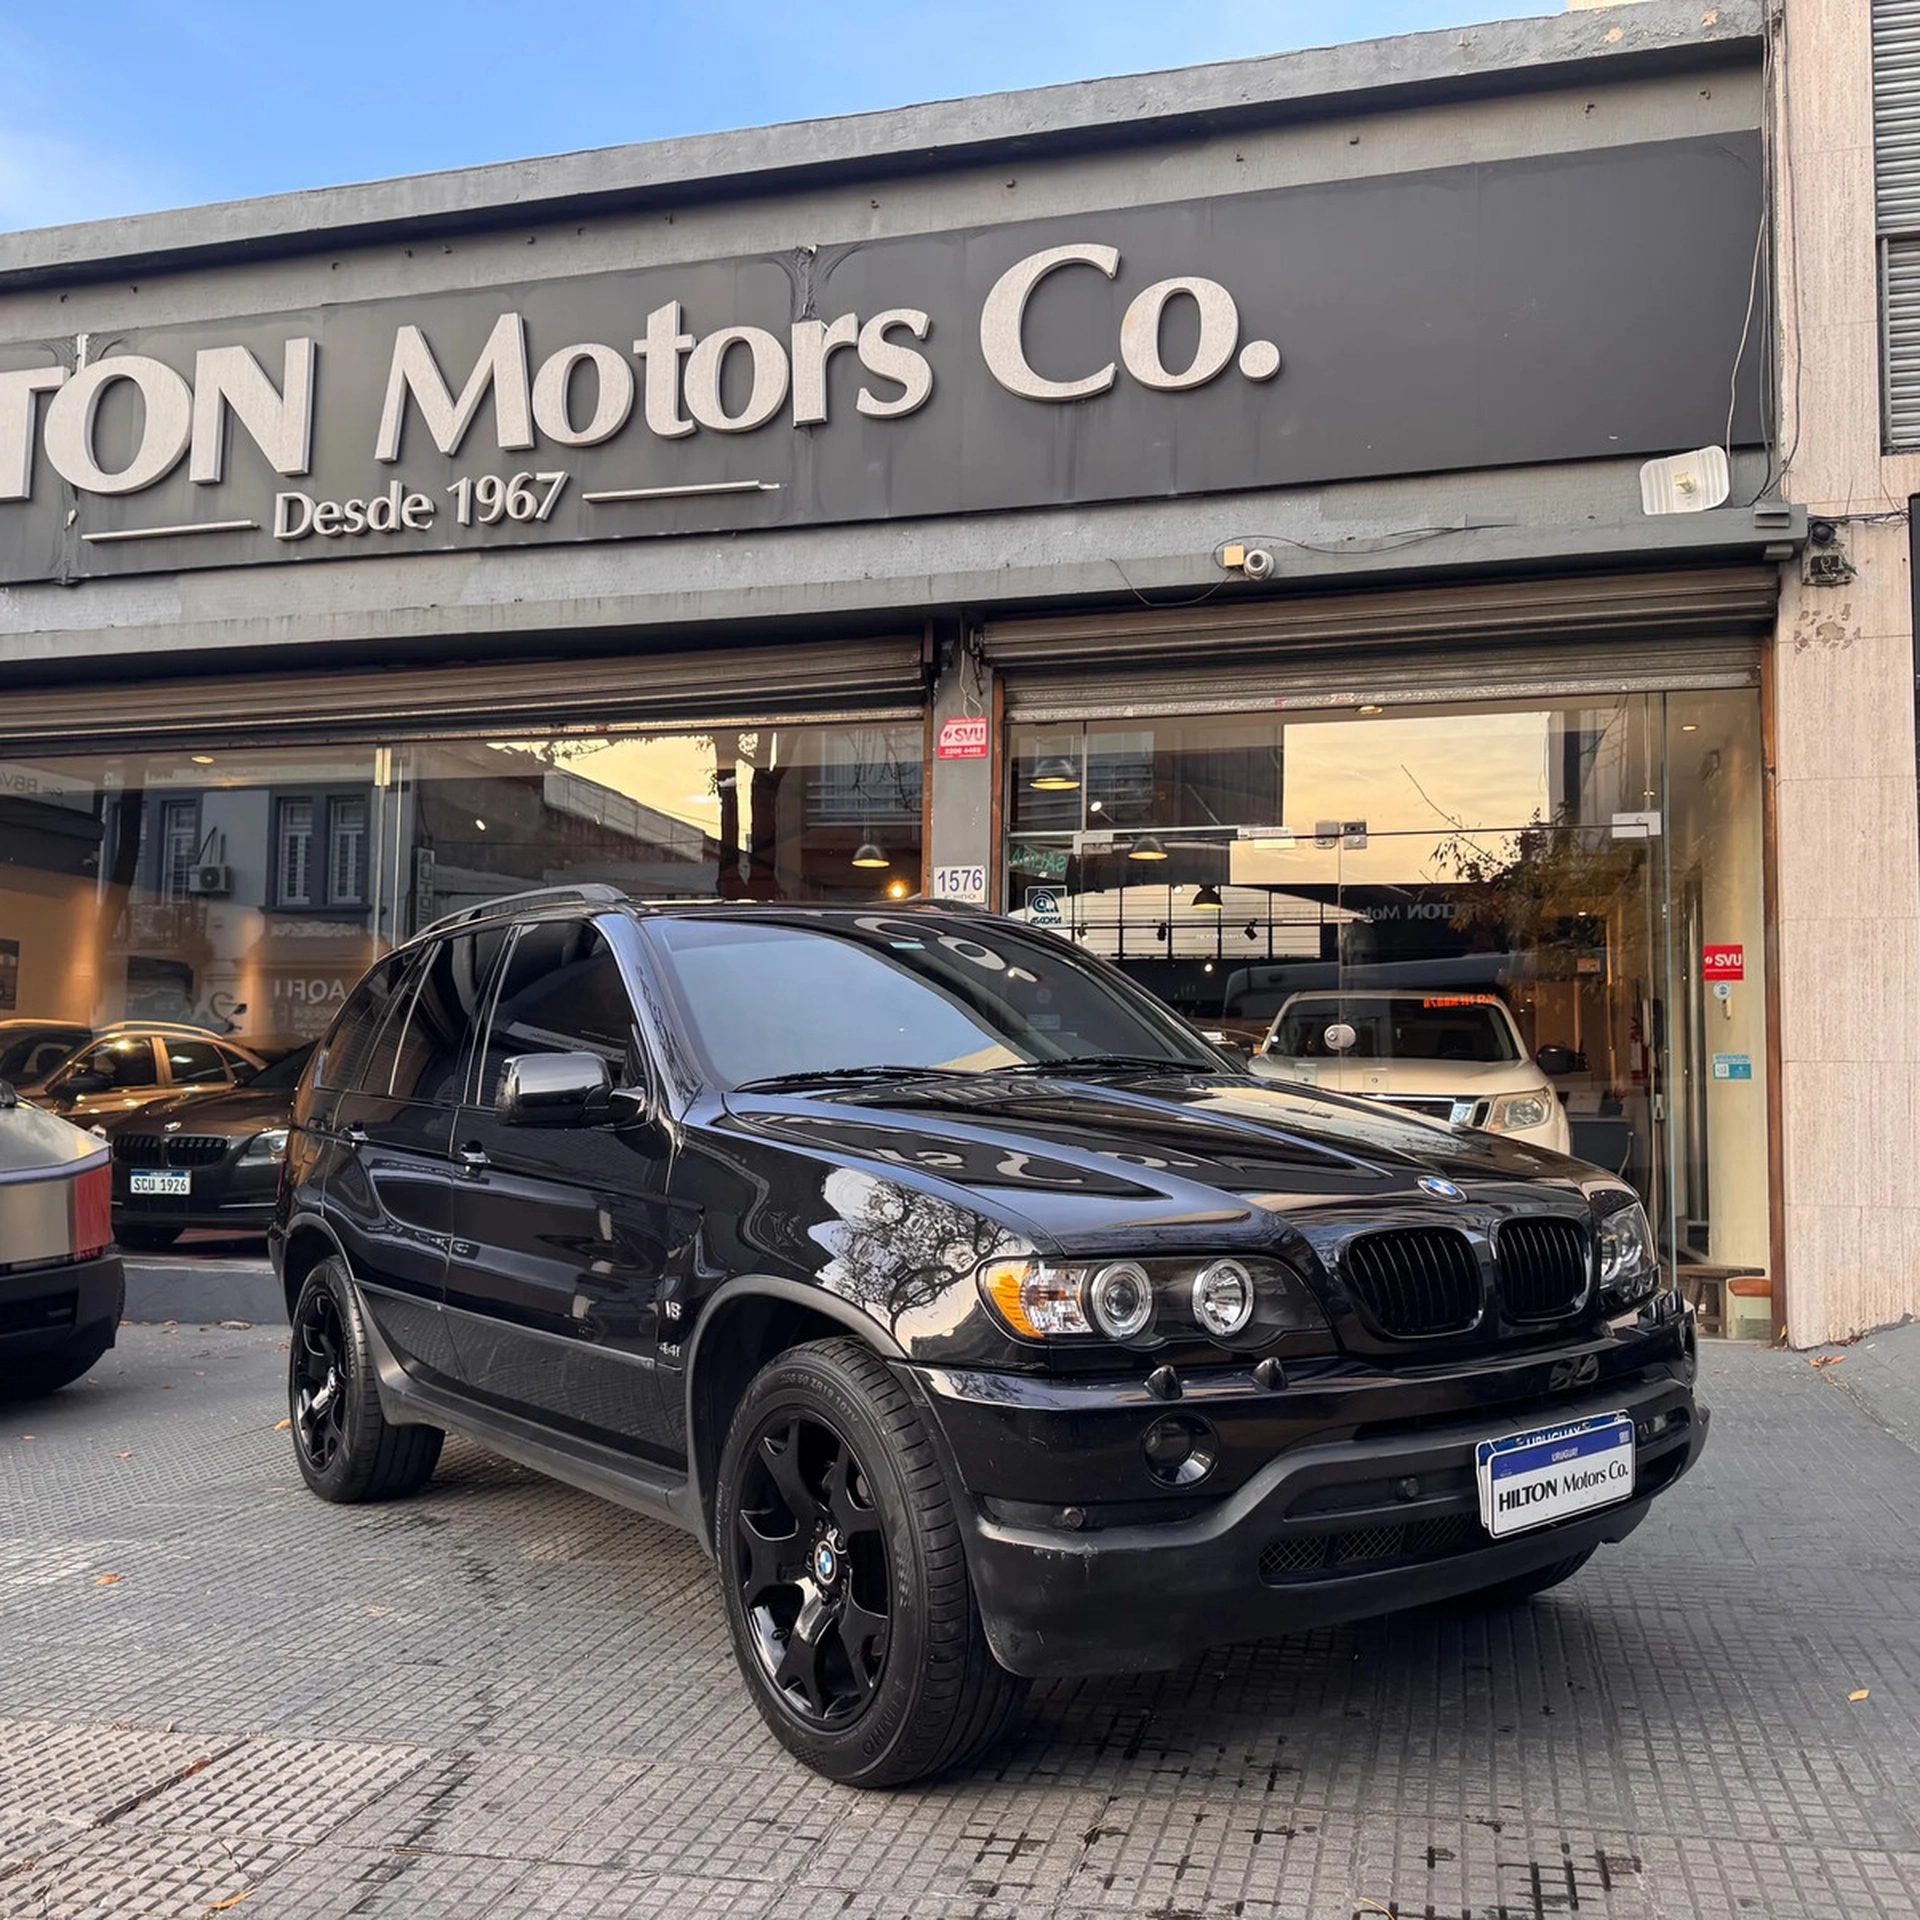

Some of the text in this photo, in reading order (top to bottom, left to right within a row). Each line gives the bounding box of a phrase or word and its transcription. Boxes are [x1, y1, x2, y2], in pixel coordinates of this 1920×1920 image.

[374, 300, 933, 463] Motors
[979, 243, 1282, 402] Co.
[273, 470, 570, 541] Desde 1967
[954, 727, 984, 742] SVU
[938, 869, 983, 892] 1576
[1714, 953, 1742, 967] SVU
[134, 1178, 187, 1192] SCU 1926
[1499, 1460, 1629, 1512] HILTON Motors Co.
